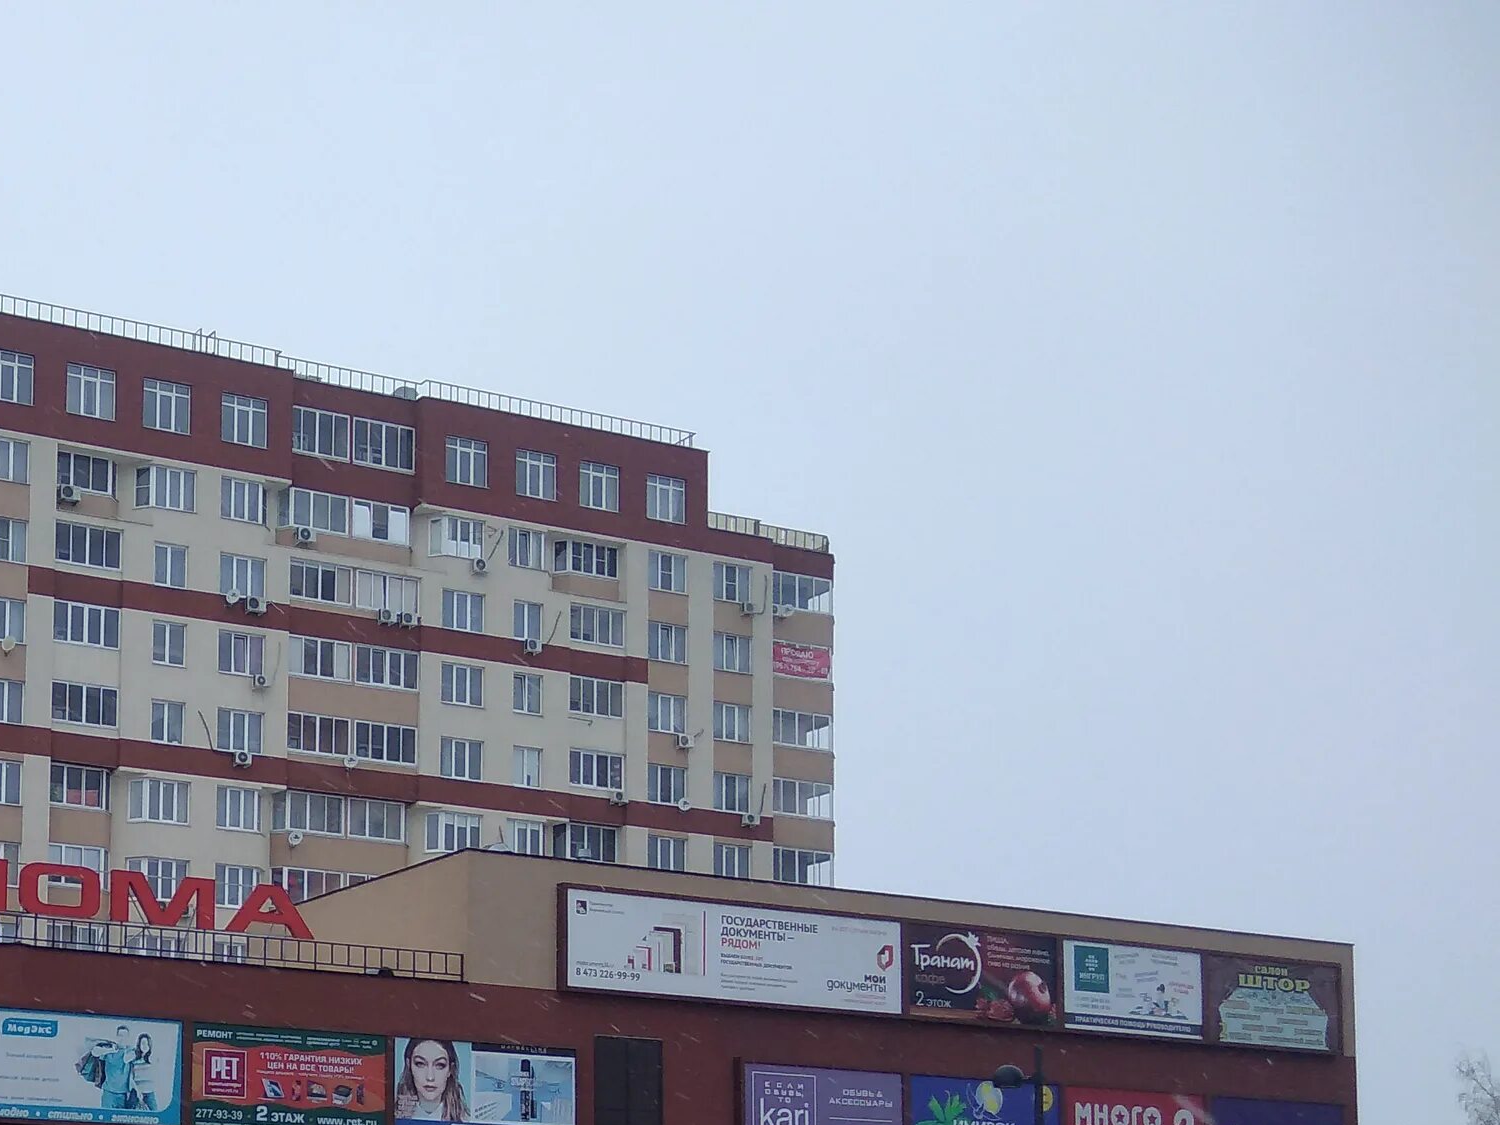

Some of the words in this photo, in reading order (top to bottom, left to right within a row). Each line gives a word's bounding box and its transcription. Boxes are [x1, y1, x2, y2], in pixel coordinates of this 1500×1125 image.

[721, 915, 818, 935] ГОСУДАРСТВЕННЫЕ
[721, 927, 786, 942] ДОКУМЕНТЫ
[721, 937, 761, 950] РЯДОМ!
[576, 967, 581, 976] 8
[583, 968, 597, 977] 473
[600, 969, 640, 981] 226-99-99
[864, 974, 886, 984] мои
[1238, 974, 1311, 992] ШТОР
[916, 991, 924, 1006] 2
[196, 1029, 233, 1039] РЕМОНТ
[260, 1052, 282, 1061] 110%
[283, 1054, 327, 1063] ГАРАНТИЯ
[328, 1056, 363, 1066] НИЗКИХ
[267, 1061, 285, 1070] ЦЕН
[318, 1064, 355, 1074] ТОВАРЫ!
[843, 1088, 875, 1097] ОБУВЬ
[829, 1097, 893, 1108] АКСЕССУАРЫ
[195, 1108, 243, 1120] 277-93-39
[256, 1105, 268, 1121] 2
[271, 1112, 305, 1124] ЭТАЖ
